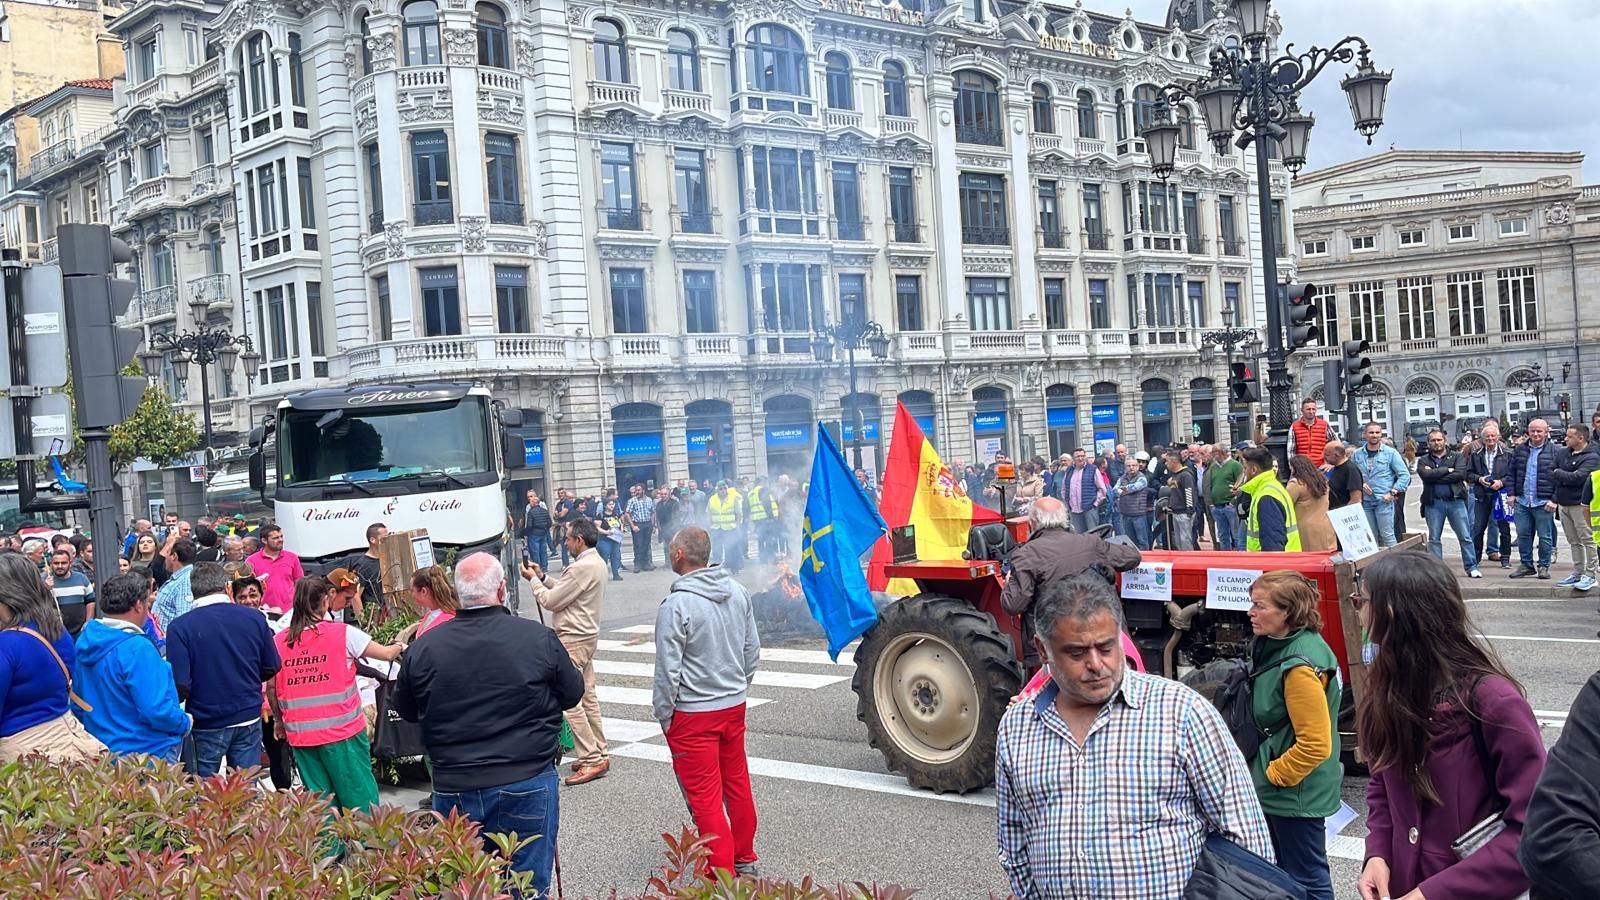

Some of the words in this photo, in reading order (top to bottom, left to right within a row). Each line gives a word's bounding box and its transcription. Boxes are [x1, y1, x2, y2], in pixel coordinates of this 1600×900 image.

[1040, 33, 1073, 53] ANTA
[1413, 357, 1492, 372] CAMPOAMOR
[419, 498, 463, 513] Olvido
[1125, 583, 1150, 591] ARRIBA
[1226, 576, 1252, 584] CAMPO
[1215, 585, 1250, 593] ASTURIAN
[284, 654, 328, 667] CIERRA
[287, 671, 330, 686] DETRÁS
